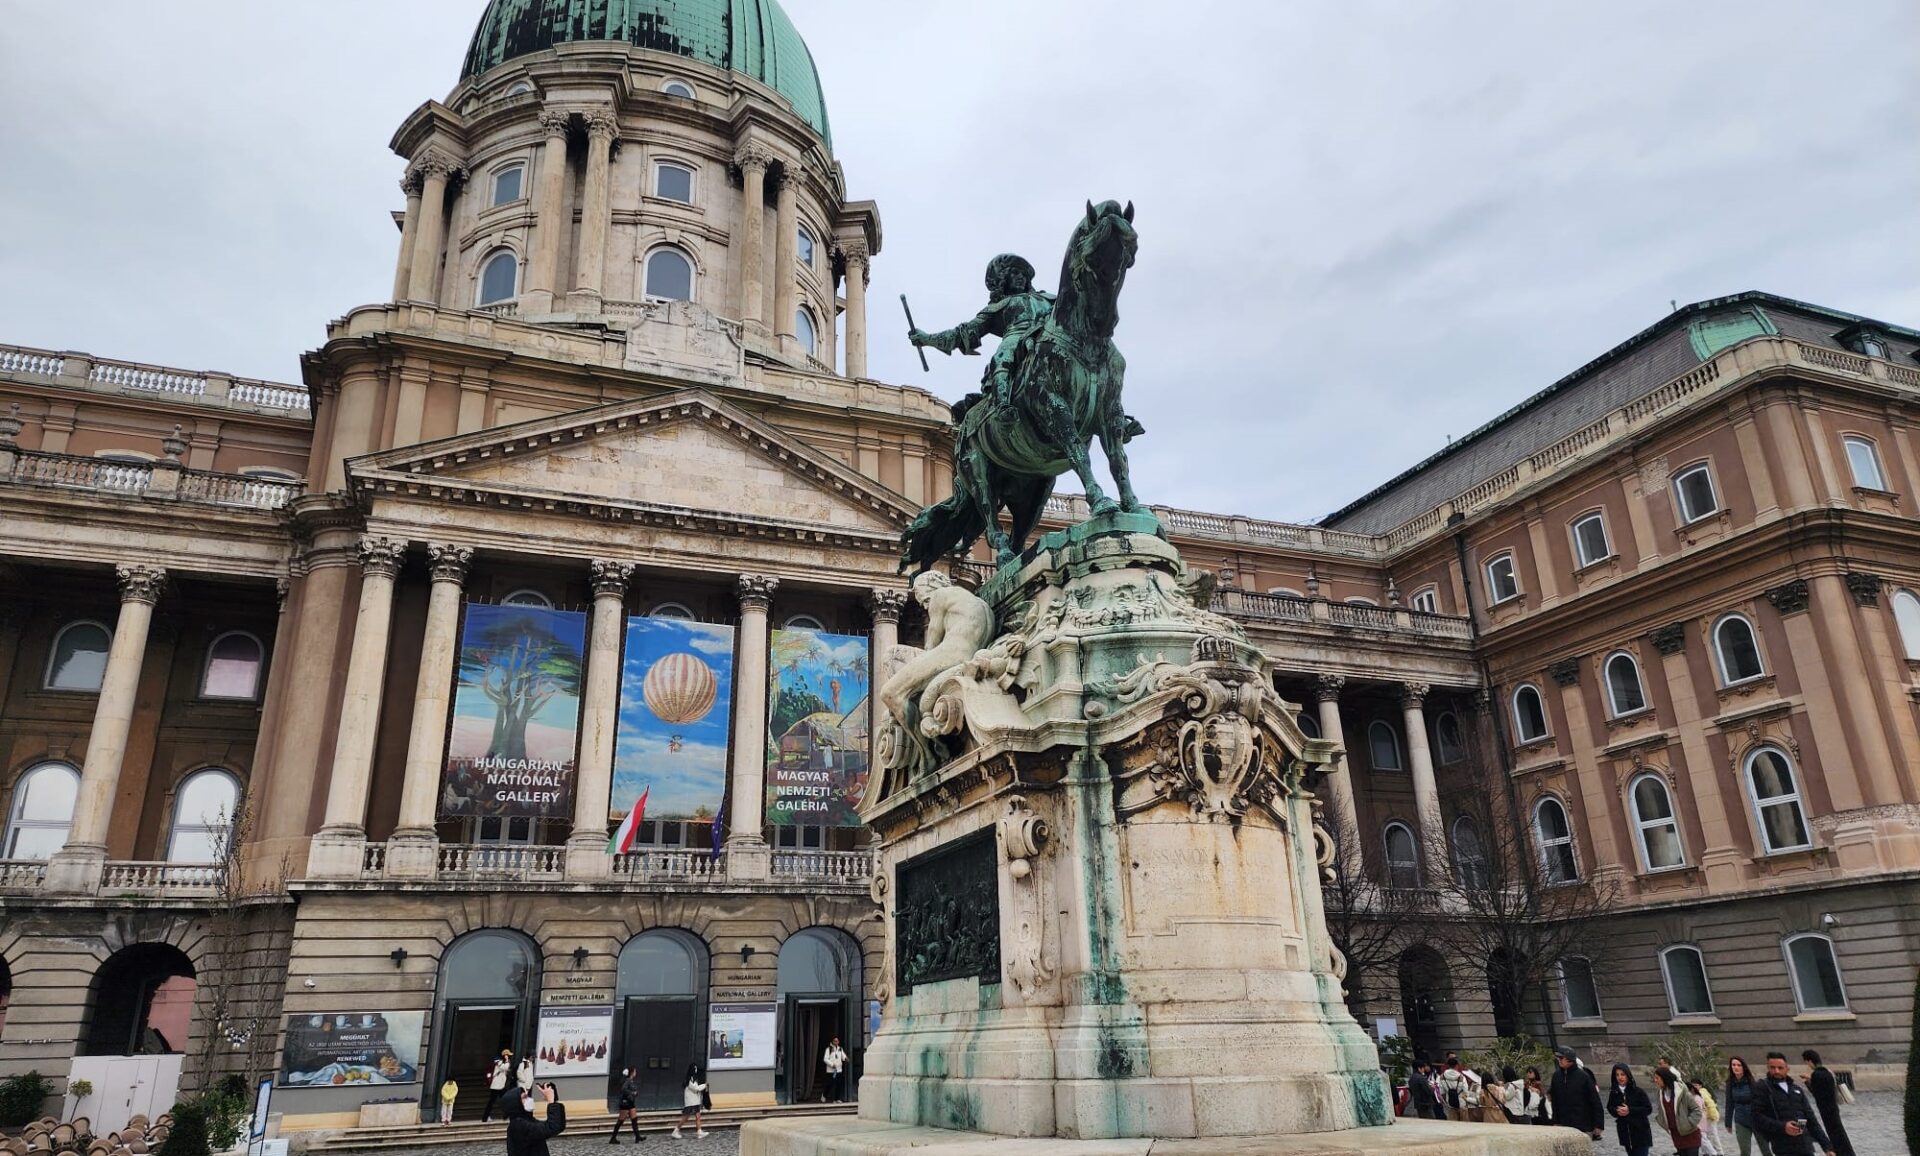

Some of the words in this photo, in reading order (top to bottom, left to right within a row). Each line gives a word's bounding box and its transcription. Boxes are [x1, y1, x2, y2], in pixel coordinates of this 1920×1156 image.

[474, 757, 562, 770] HUNGARIAN
[487, 774, 561, 787] NATIONAL
[777, 770, 830, 782] MAGYAR
[495, 790, 560, 803] GALLERY
[776, 785, 830, 797] NEMZETI
[776, 798, 829, 811] GALÉRIA
